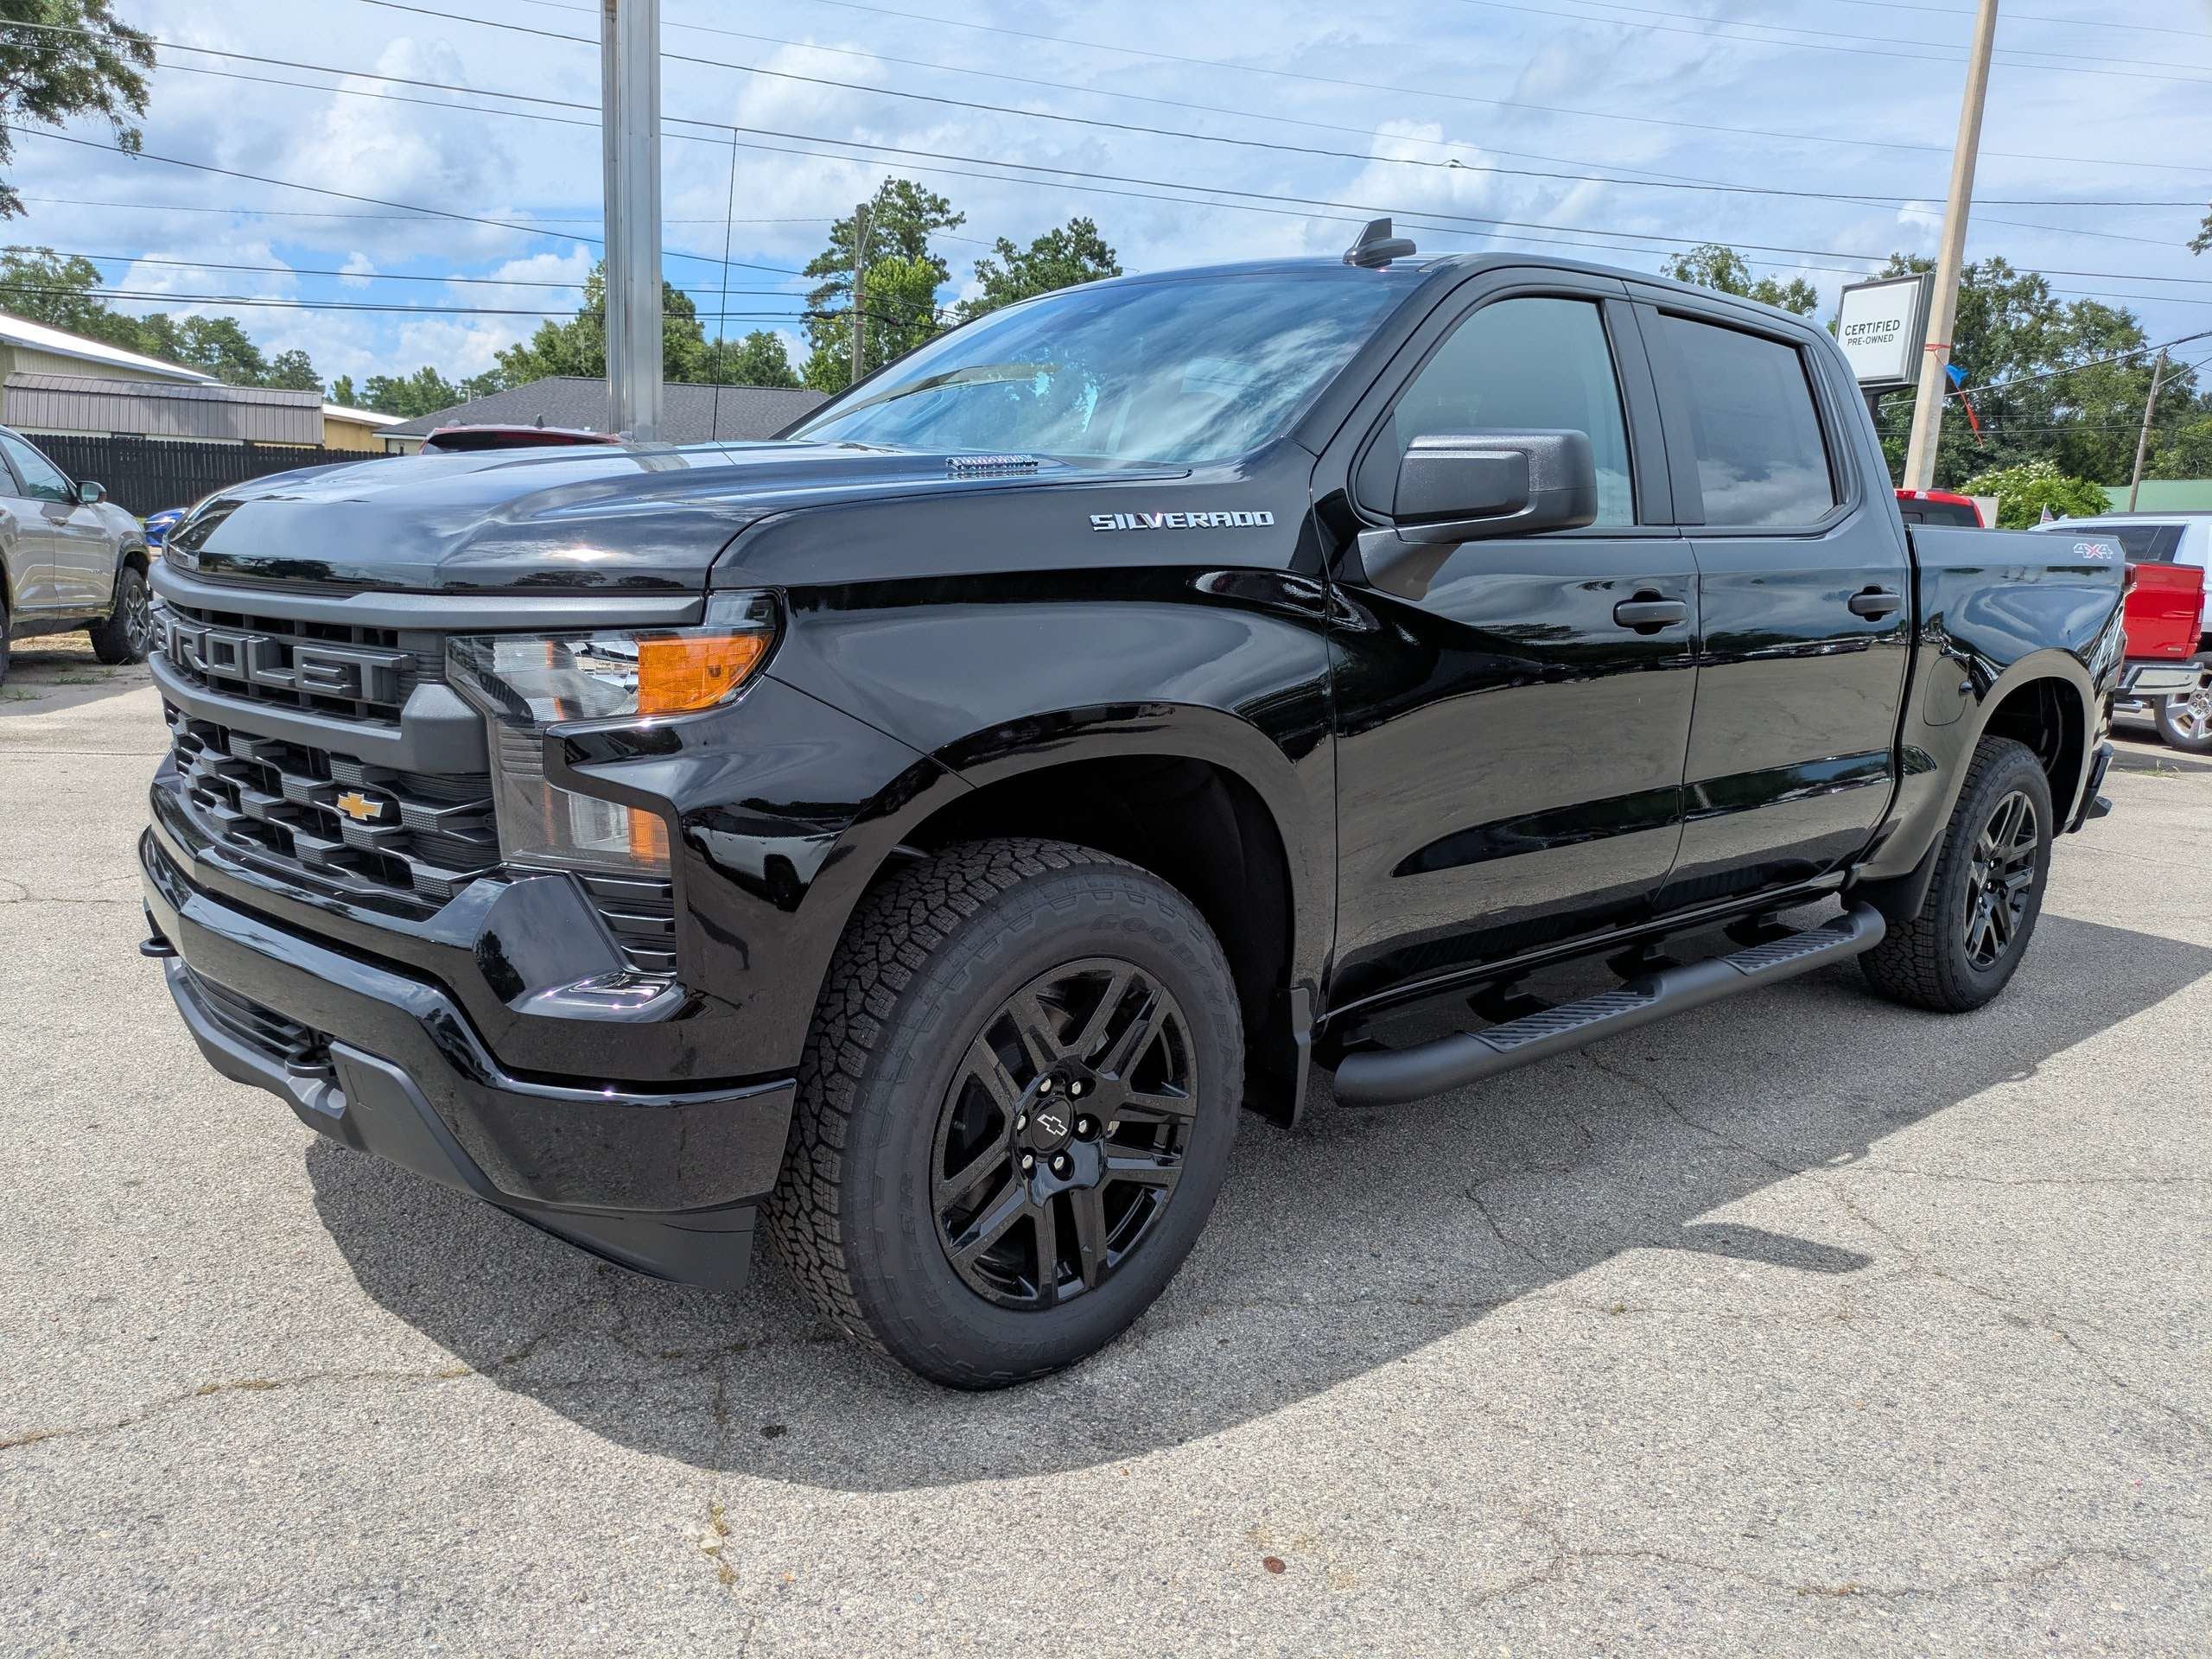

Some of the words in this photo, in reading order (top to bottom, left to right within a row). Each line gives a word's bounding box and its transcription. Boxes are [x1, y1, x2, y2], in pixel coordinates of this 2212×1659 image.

[1845, 320, 1900, 336] CERTIFIED
[1847, 334, 1894, 346] PRE-OWNED
[1090, 511, 1275, 531] SILVERADO
